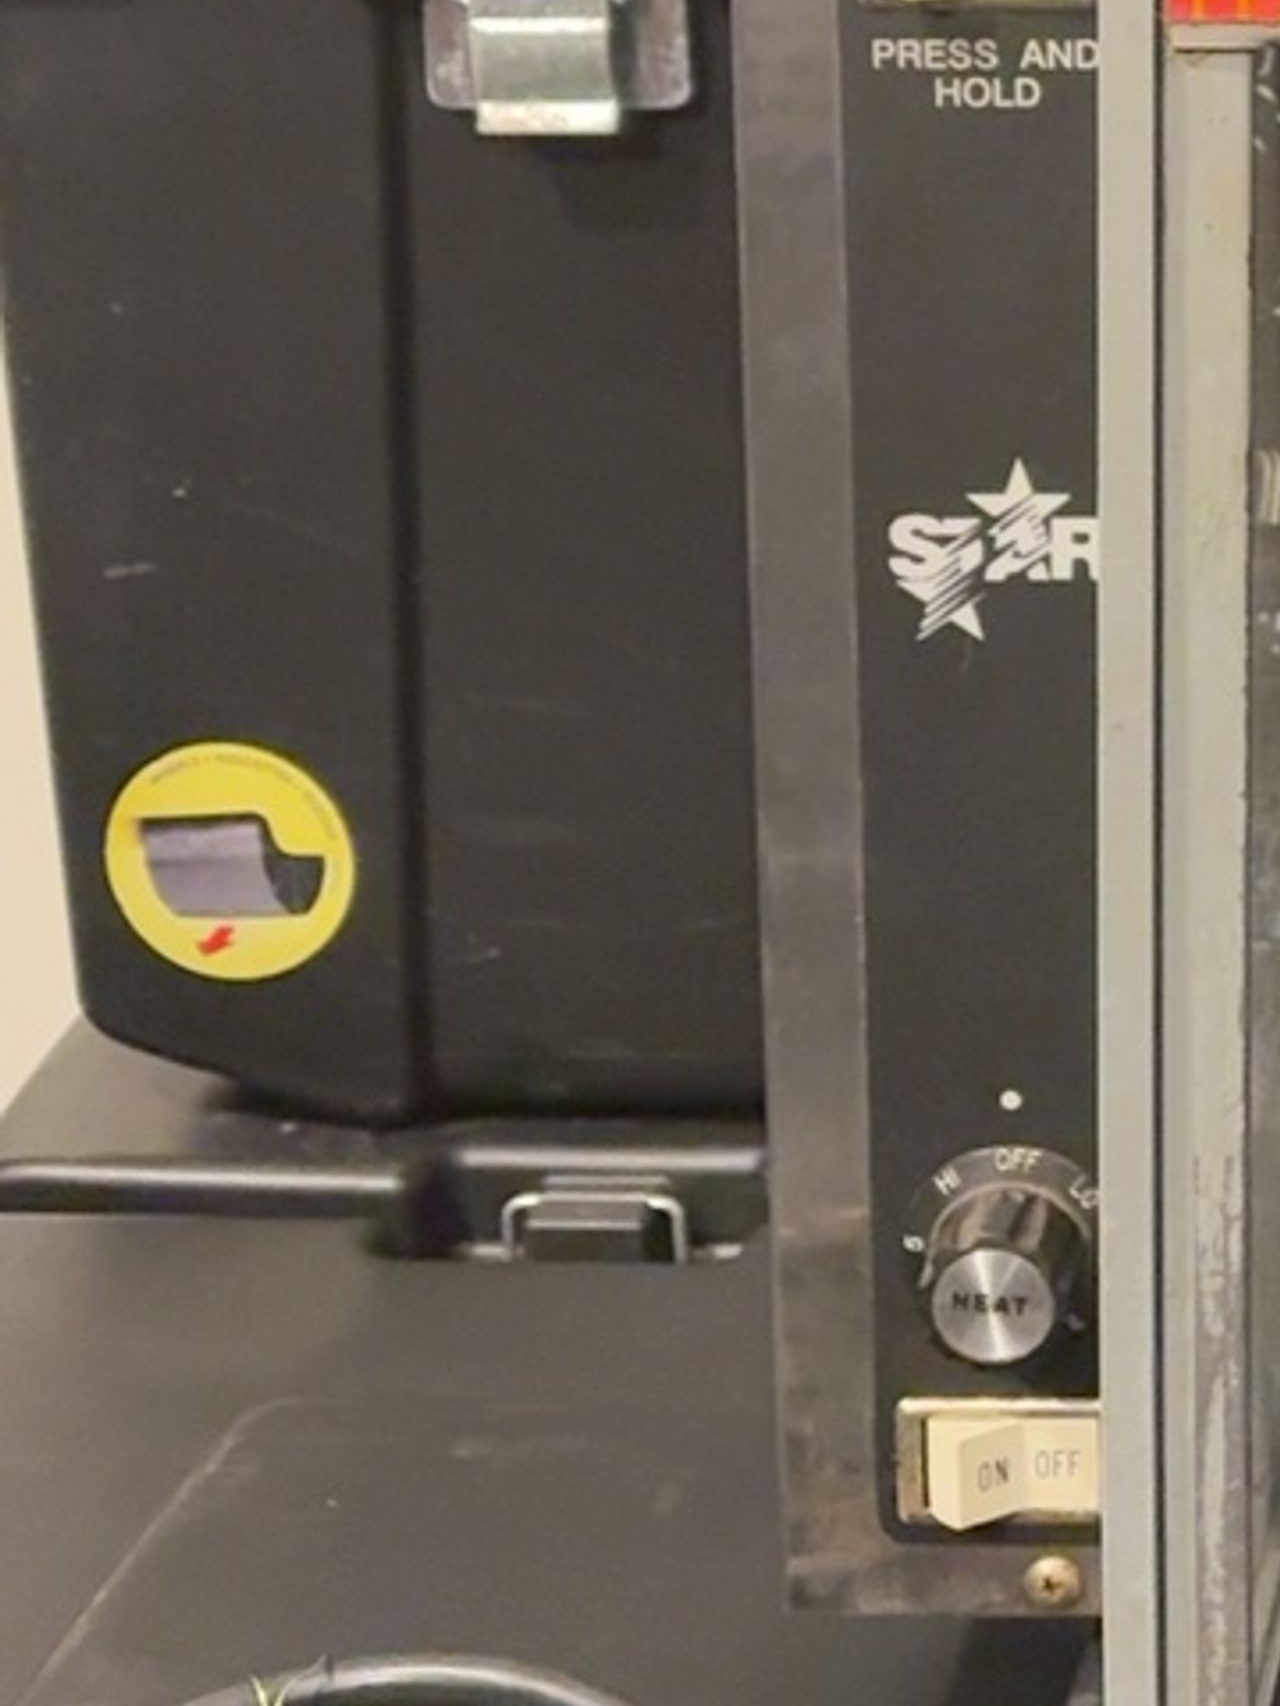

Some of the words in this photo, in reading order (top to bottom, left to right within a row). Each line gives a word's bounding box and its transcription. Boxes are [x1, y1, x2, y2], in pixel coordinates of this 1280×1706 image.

[871, 38, 999, 71] PRESS
[1020, 38, 1099, 71] AND
[935, 77, 1042, 108] HOLD
[994, 1148, 1044, 1174] OFF
[932, 1167, 962, 1195] HI
[951, 1292, 1029, 1316] HEAT
[976, 1456, 1010, 1493] ON
[1034, 1449, 1082, 1479] OFF
